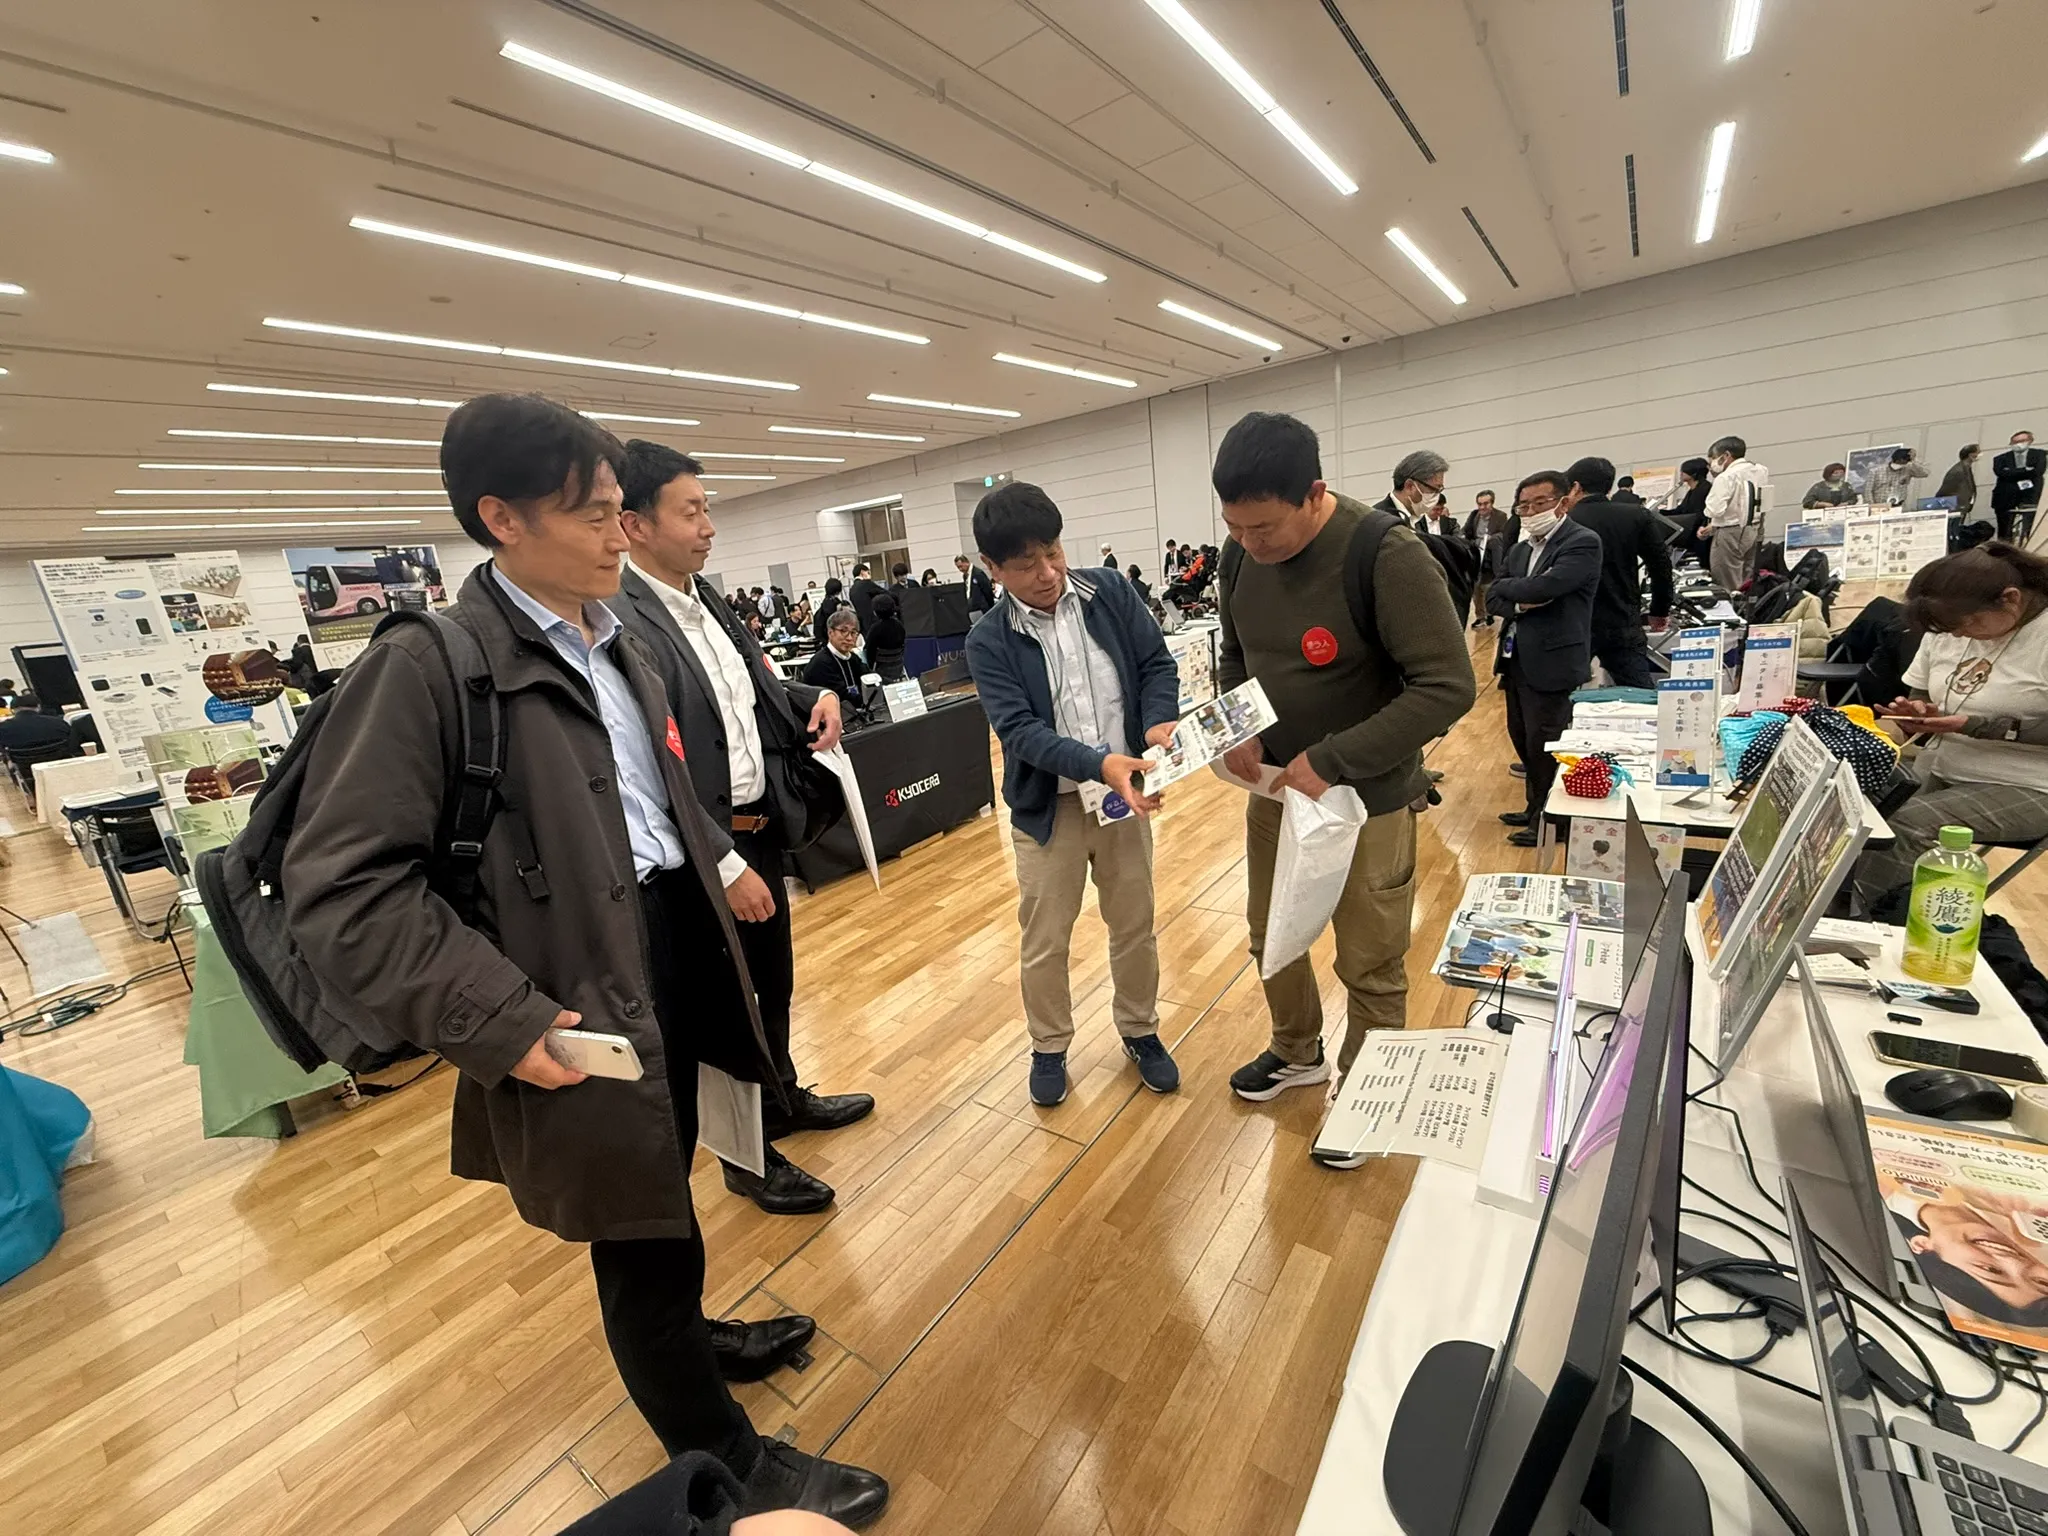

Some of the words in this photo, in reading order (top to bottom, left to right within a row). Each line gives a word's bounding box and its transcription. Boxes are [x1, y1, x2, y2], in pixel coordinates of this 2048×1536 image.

[897, 772, 940, 802] KYOCERA
[1932, 887, 1965, 923] 綾鷹
[1880, 1167, 1949, 1187] mimioto
